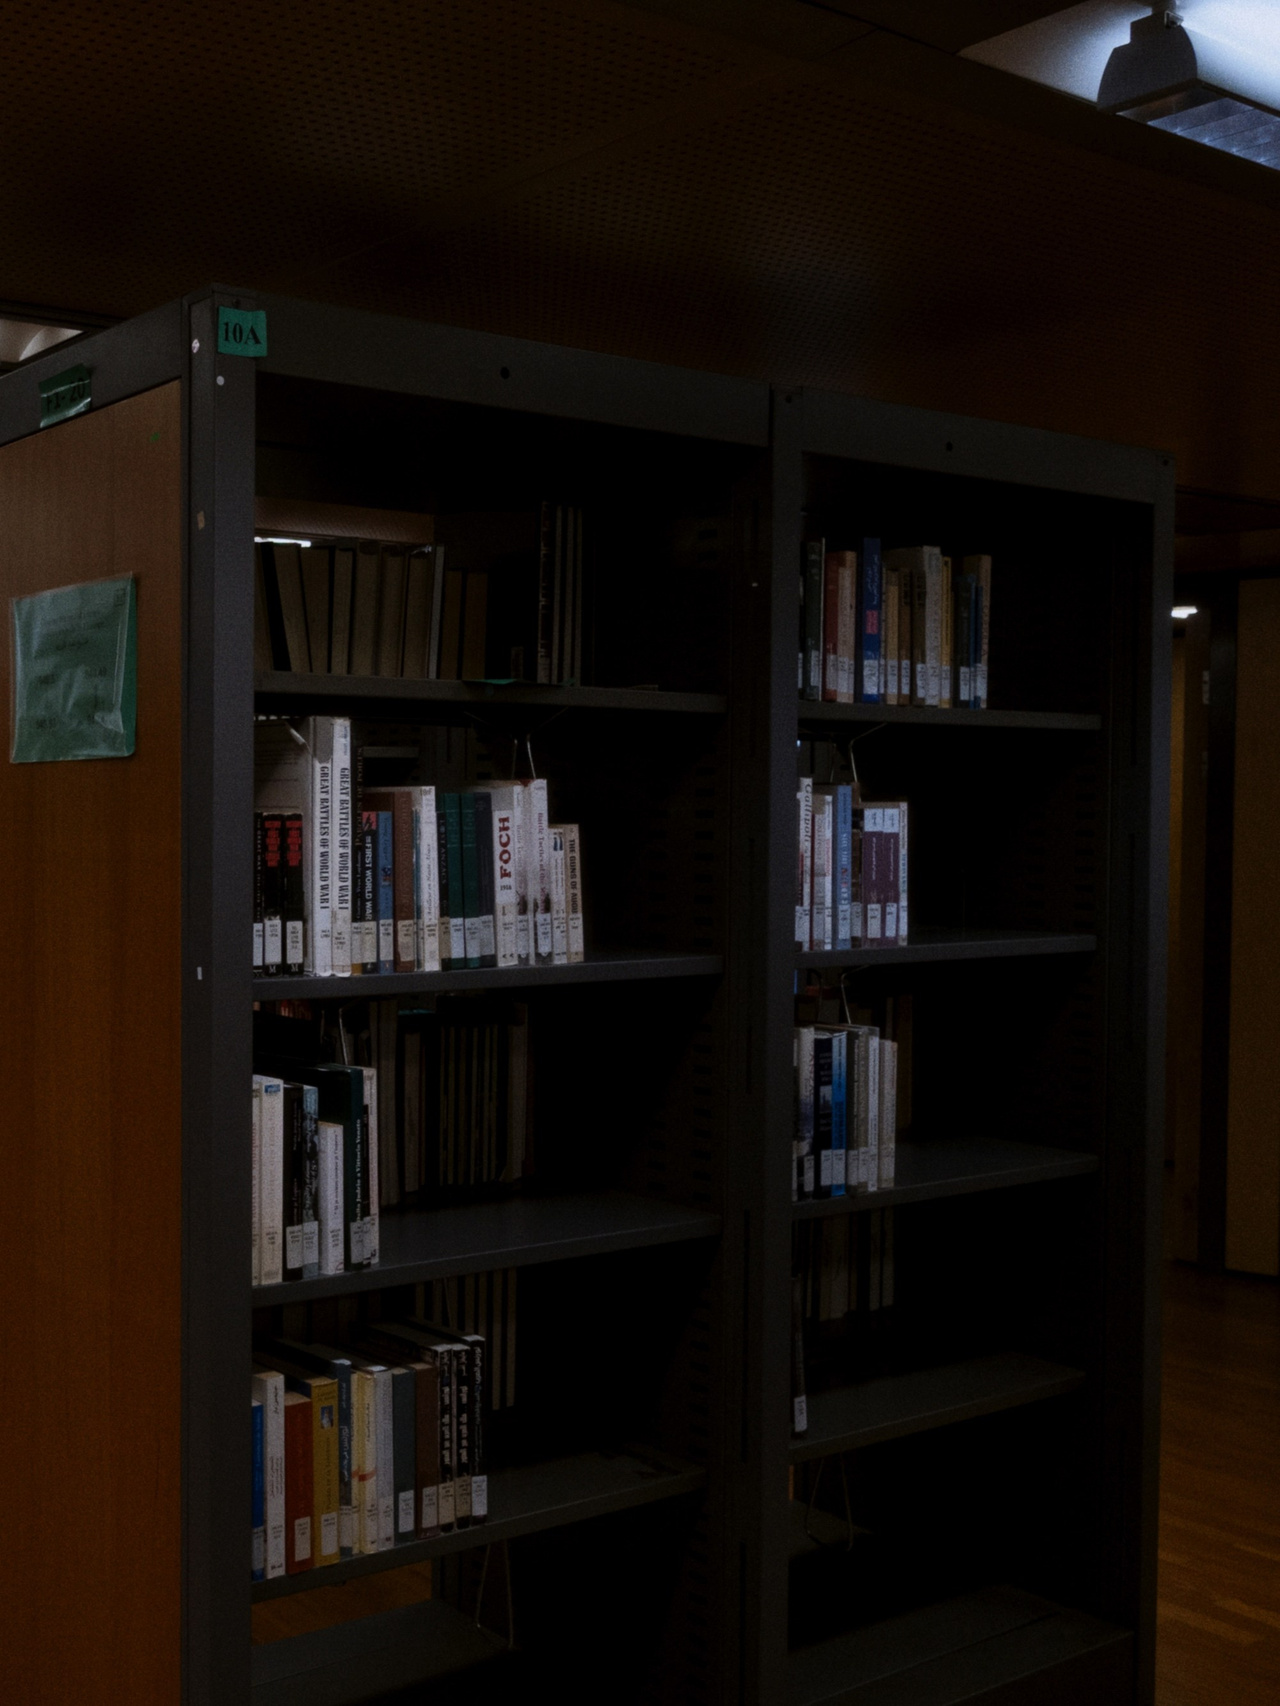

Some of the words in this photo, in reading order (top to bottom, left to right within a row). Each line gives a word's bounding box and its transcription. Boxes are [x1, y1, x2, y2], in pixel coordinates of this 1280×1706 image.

[223, 321, 262, 345] 10A
[320, 766, 330, 796] GREAT
[340, 767, 350, 797] GREAT
[320, 798, 330, 836] BATTLES
[339, 799, 350, 837] BATTLES
[803, 783, 812, 843] Gallipoli
[320, 838, 330, 849] OF
[339, 839, 350, 850] OF
[364, 844, 373, 868] FIRST
[498, 816, 511, 879] FOCH
[320, 851, 330, 882] WORLD
[338, 852, 350, 883] WORLD
[320, 884, 330, 904] WAR
[338, 885, 350, 905] WAR
[364, 869, 373, 900] WORLD
[570, 881, 577, 890] OF
[364, 901, 373, 920] WAR
[570, 892, 578, 914] AUGU
